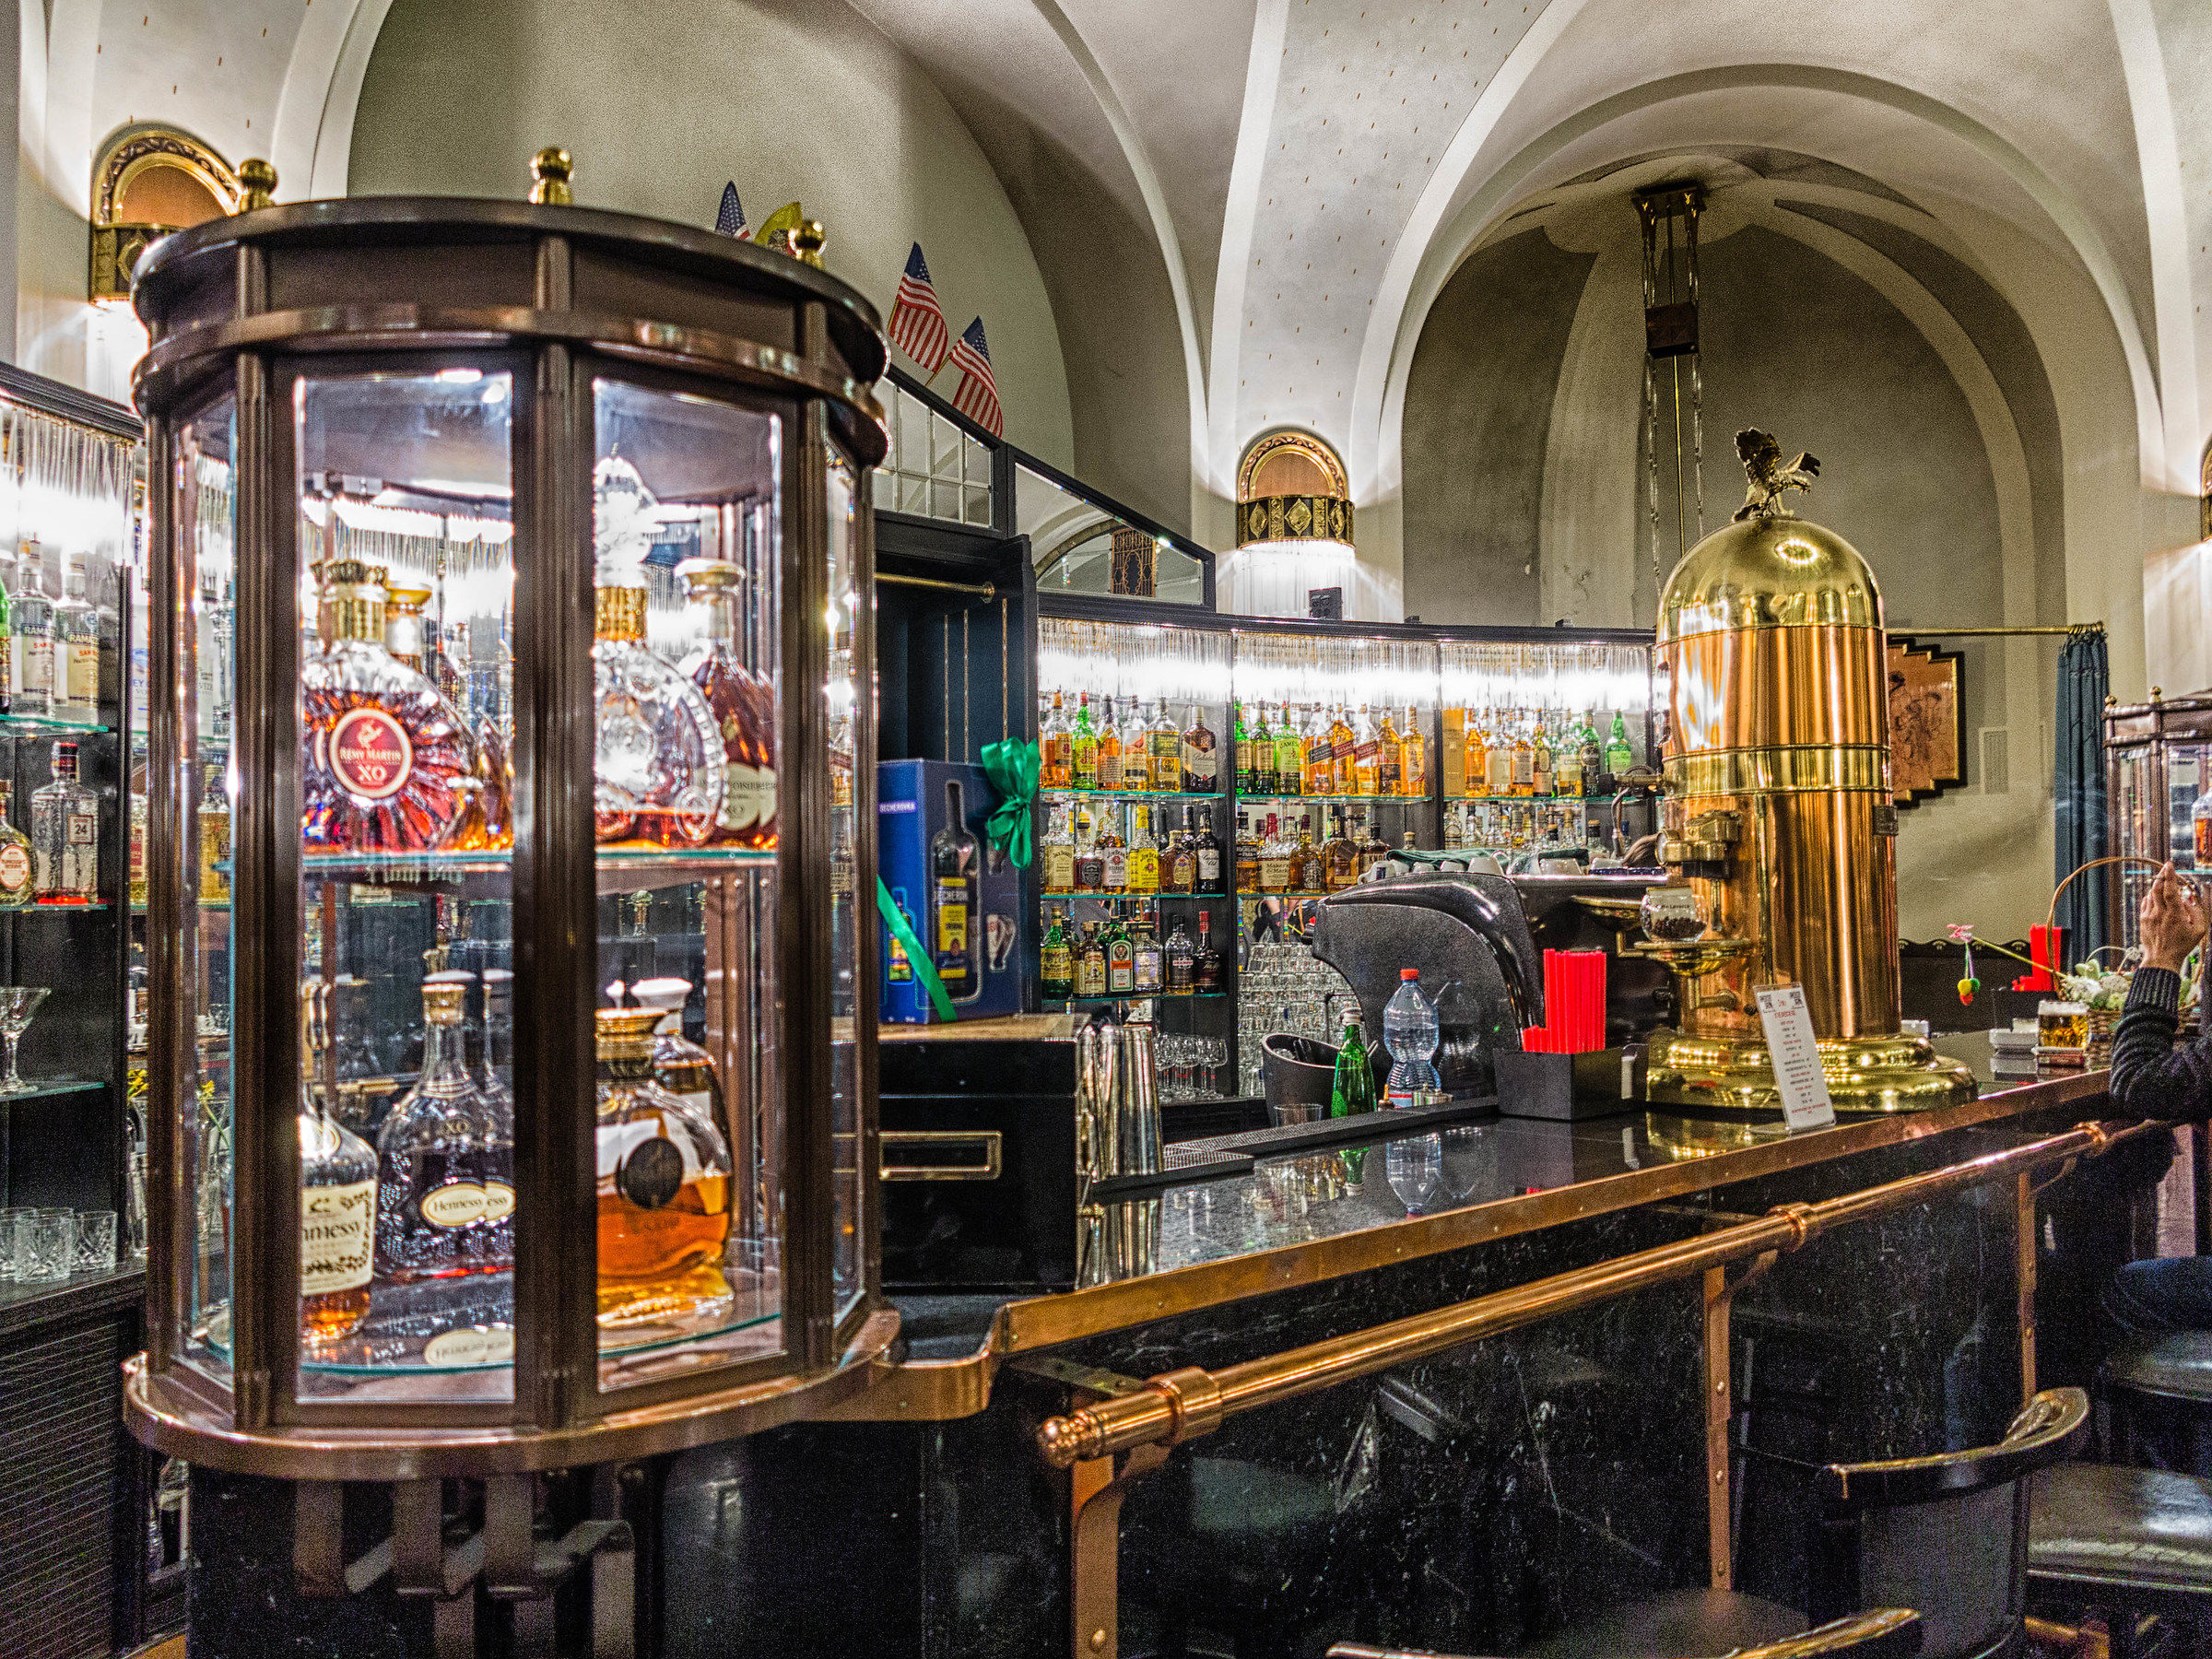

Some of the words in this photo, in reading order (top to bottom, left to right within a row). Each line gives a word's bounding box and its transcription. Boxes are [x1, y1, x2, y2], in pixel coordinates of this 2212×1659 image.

[358, 764, 387, 782] XO
[75, 823, 88, 835] 24
[432, 1198, 484, 1212] Hennessy
